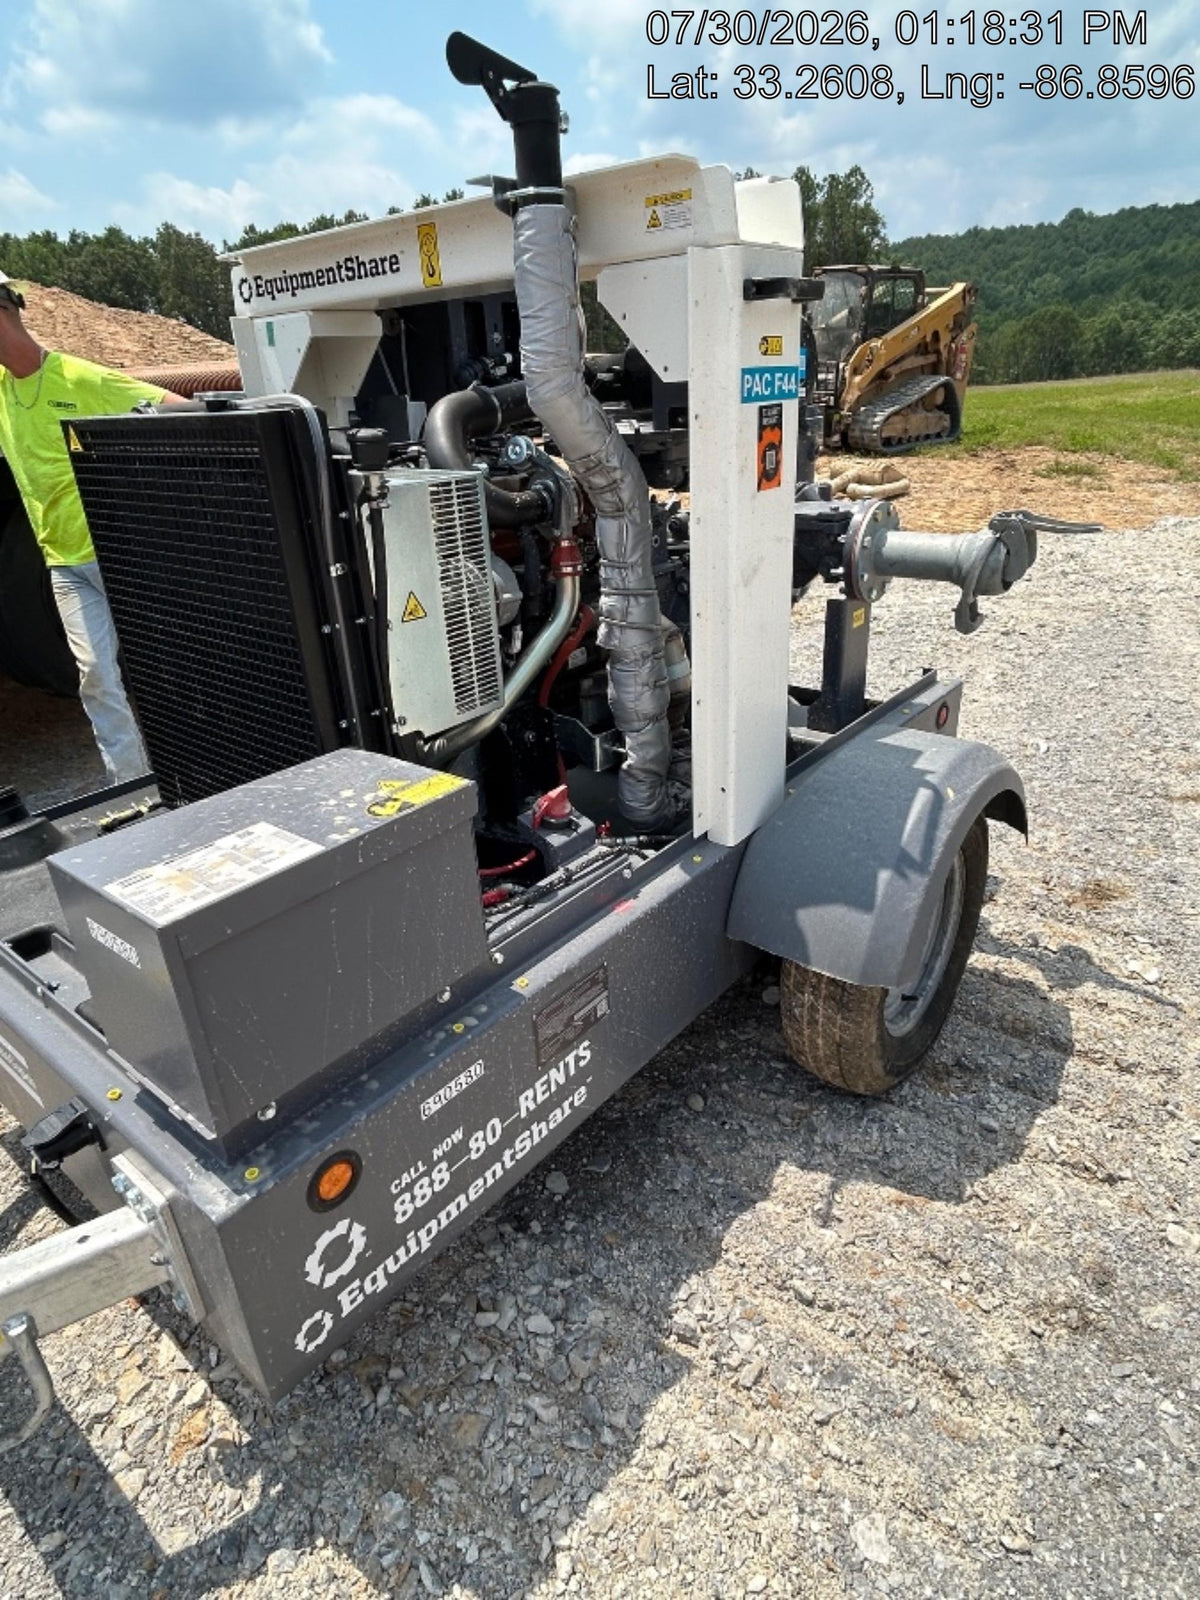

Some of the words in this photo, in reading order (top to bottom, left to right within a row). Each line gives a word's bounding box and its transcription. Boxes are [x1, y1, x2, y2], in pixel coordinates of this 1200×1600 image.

[254, 252, 401, 301] EquipmentShare
[742, 372, 771, 398] PAC
[774, 372, 797, 396] F44
[390, 1160, 428, 1194] CALL
[432, 1125, 464, 1162] NOW
[337, 1085, 588, 1319] EquipmentShare
